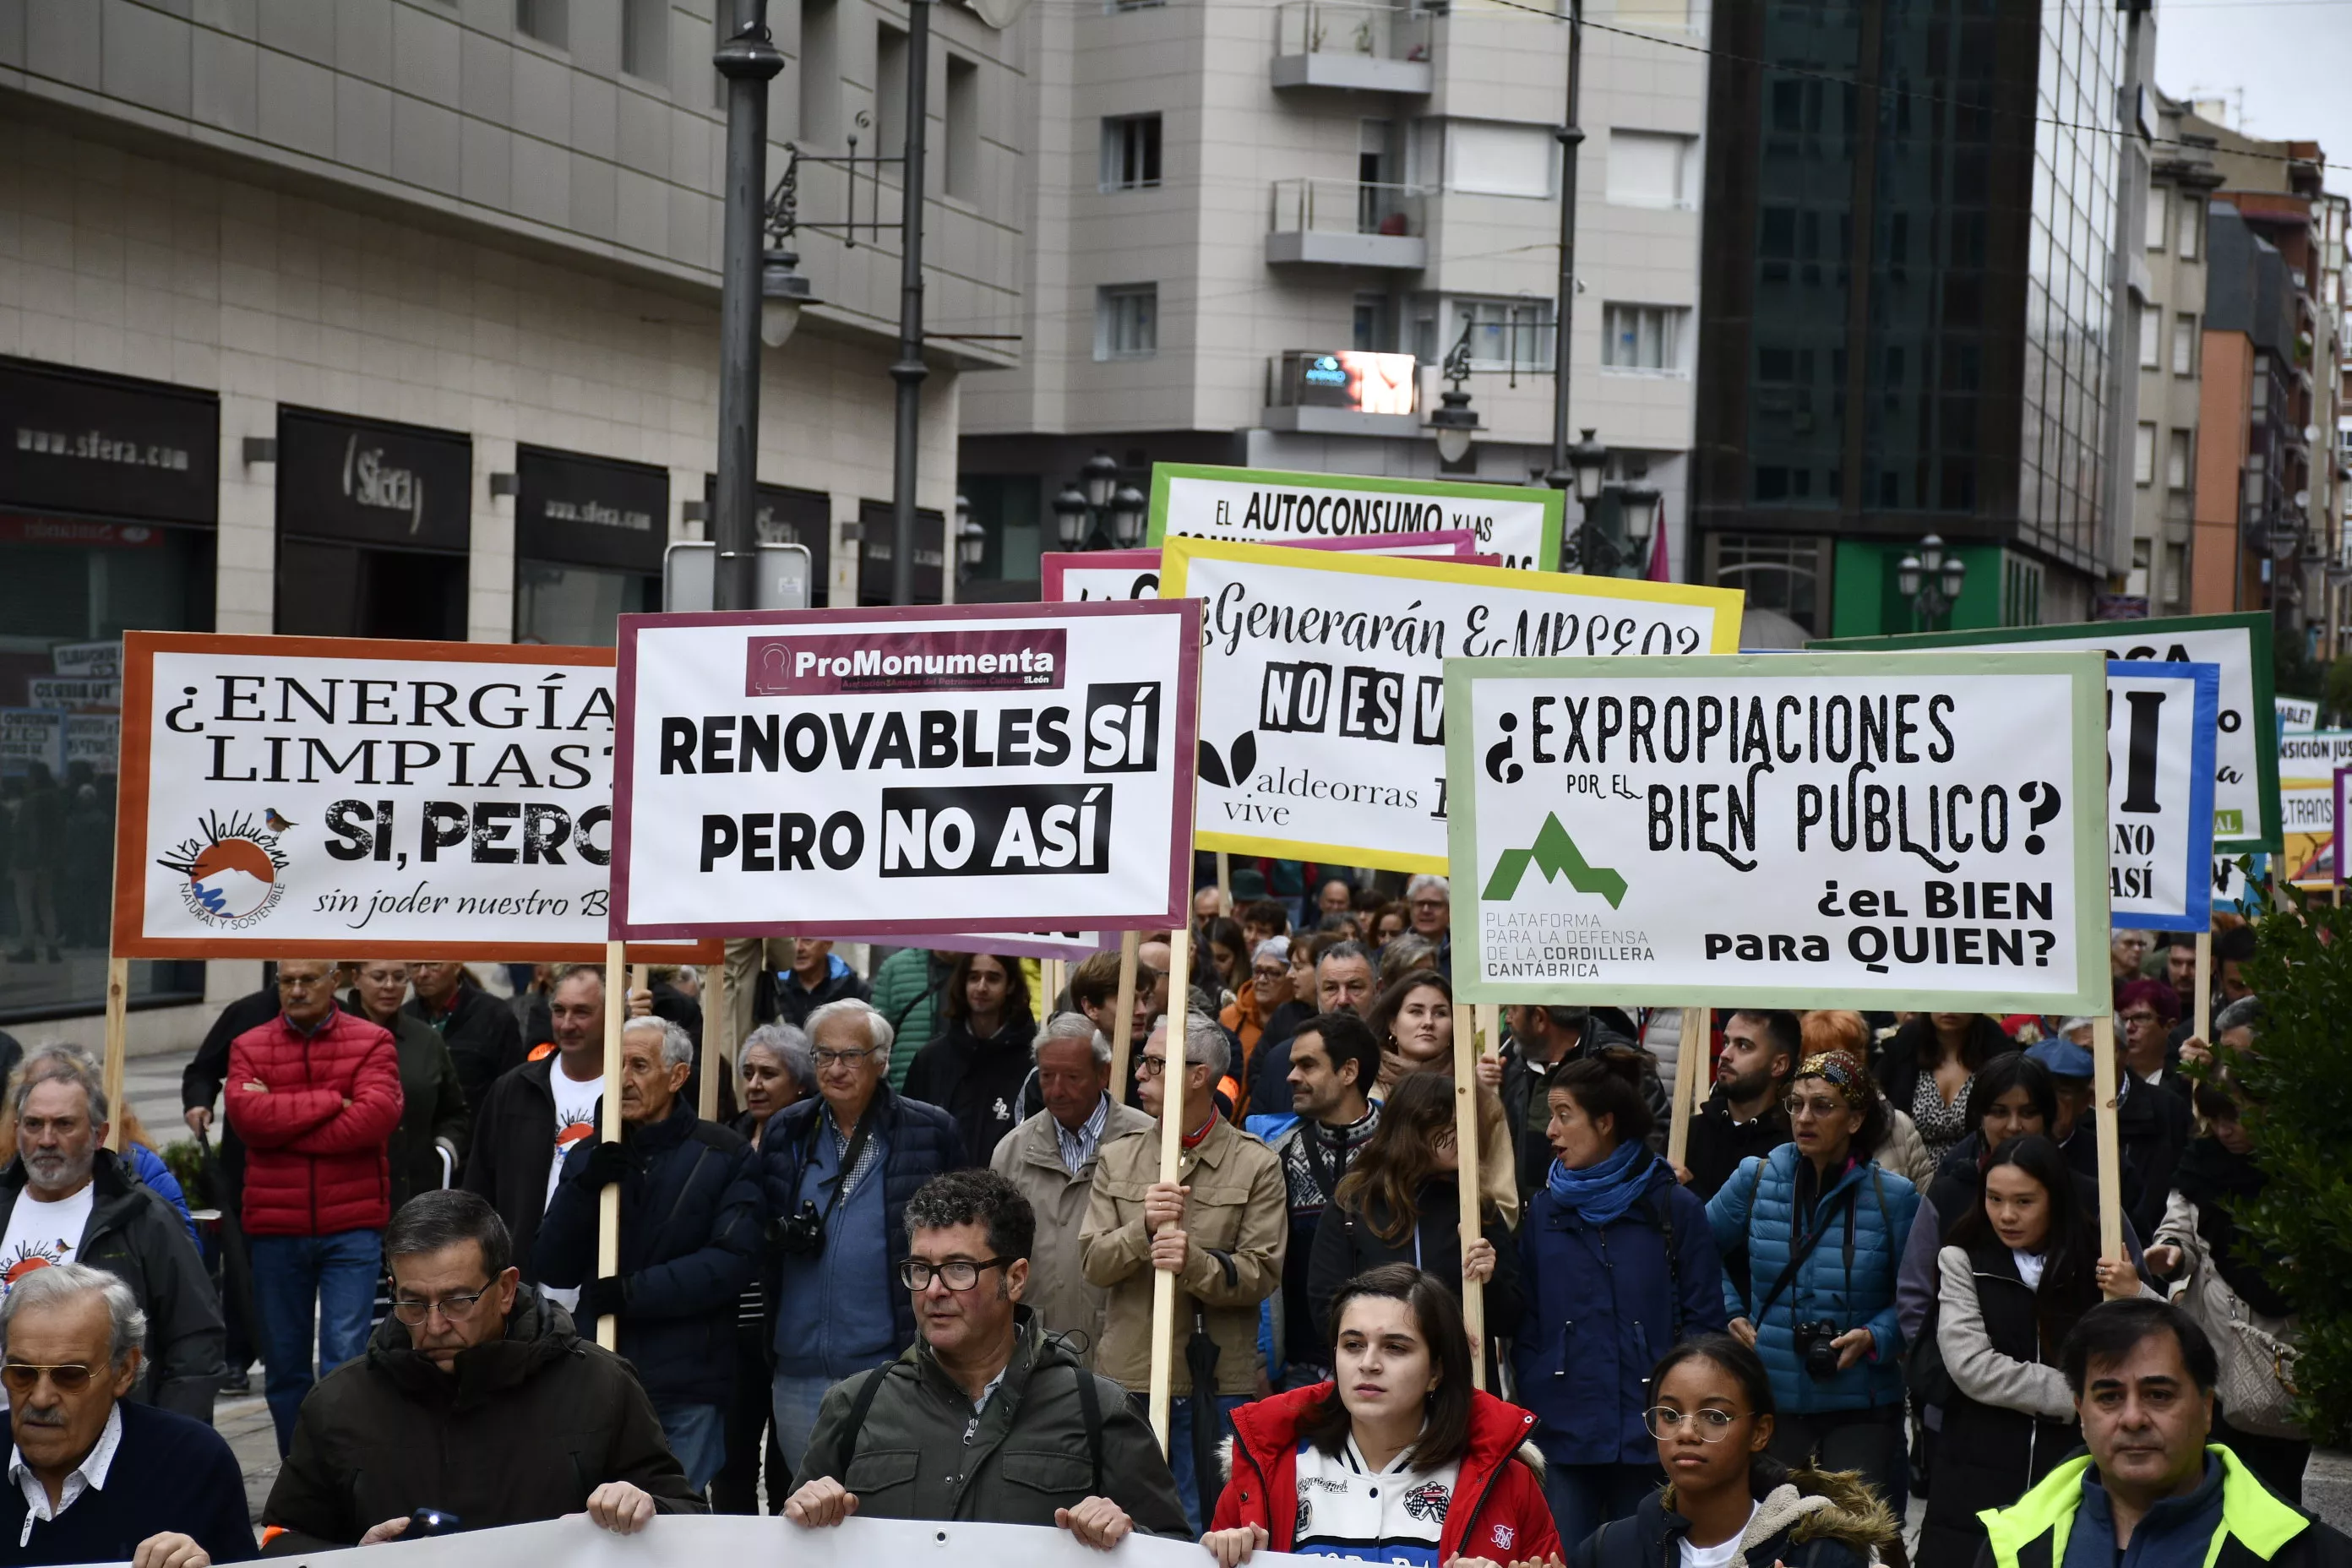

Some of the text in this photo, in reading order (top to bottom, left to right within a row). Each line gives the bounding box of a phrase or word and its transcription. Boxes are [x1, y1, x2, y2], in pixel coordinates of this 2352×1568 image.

[1216, 500, 1232, 525] EL
[1243, 492, 1442, 536] AUTOCONSUMO
[795, 647, 1054, 678] ProMonumenta
[1029, 675, 1049, 683] León
[1265, 668, 1326, 727] NO
[1347, 675, 1400, 736] ES
[660, 687, 1154, 775] RENOVABLES SÍ
[1486, 694, 1955, 784] ¿EXPROPIACIONES
[1257, 766, 1418, 809] aldeorras
[700, 787, 1103, 873] PERO NO ASÍ
[1223, 794, 1290, 826] vive
[1567, 775, 1607, 799] POR
[1612, 775, 1643, 799] EL
[1648, 763, 1772, 871] BIEN
[421, 801, 612, 866] PERO
[156, 837, 208, 877] Alta
[179, 882, 215, 928] NATURAL
[231, 882, 286, 930] SOSTENIBLE
[313, 889, 358, 914] sin
[346, 880, 449, 929] joder
[456, 889, 569, 916] nuestro
[1486, 912, 1601, 928] PLATAFORMA
[1925, 881, 2052, 920] BIEN
[1486, 930, 1648, 945] PARA LA DEFENSA
[1487, 946, 1654, 961] DE LA CORDILLERA
[1848, 926, 2056, 974] QUIEN?
[1488, 960, 1599, 977] CANTÁBRICA
